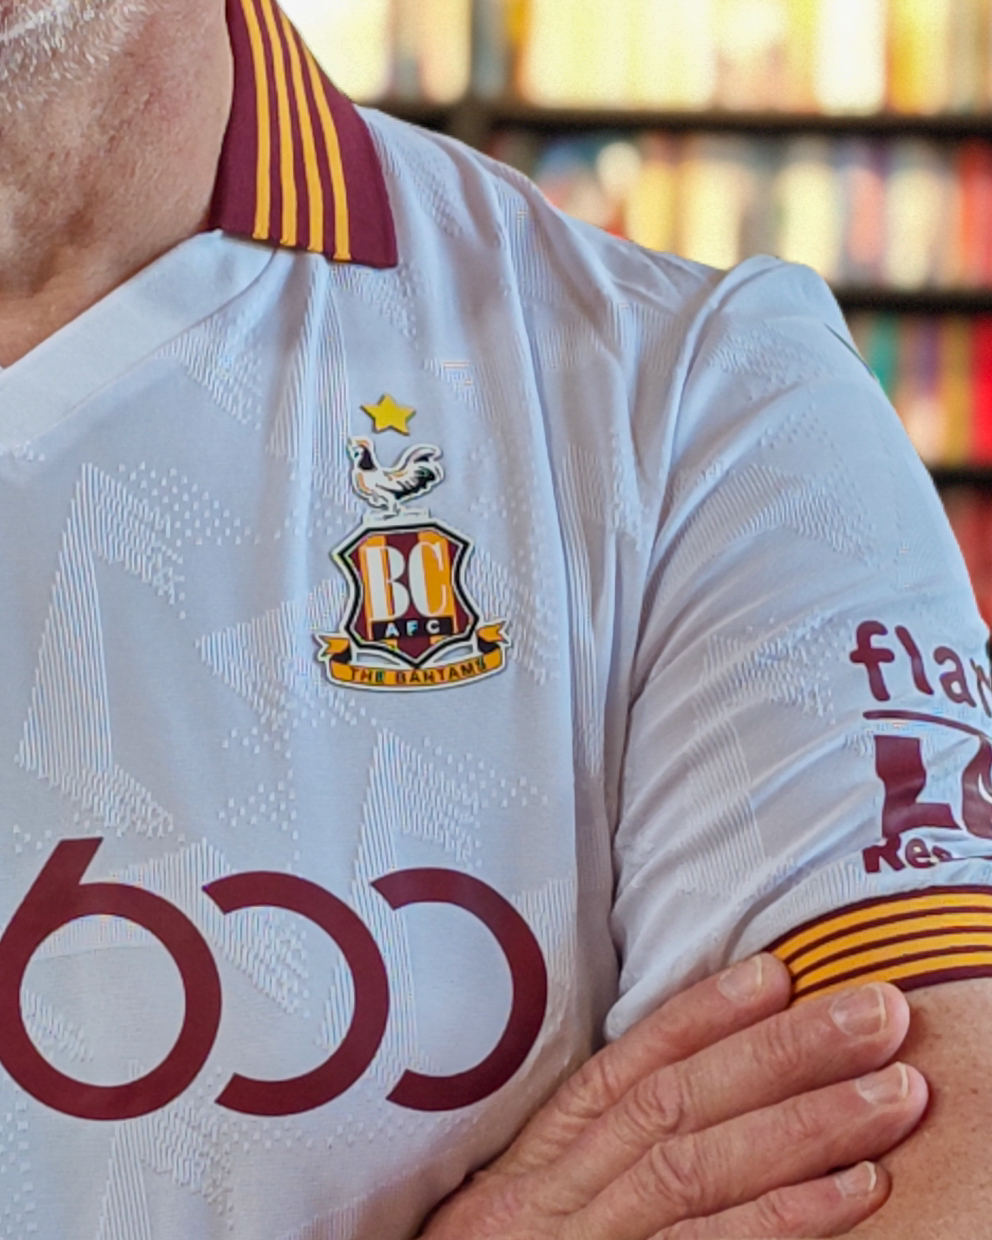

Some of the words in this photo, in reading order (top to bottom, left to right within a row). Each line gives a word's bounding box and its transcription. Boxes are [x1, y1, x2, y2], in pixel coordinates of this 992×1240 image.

[364, 541, 447, 621] BC
[385, 620, 441, 637] AFC
[351, 667, 386, 682] THE
[395, 658, 487, 684] BANTAMS
